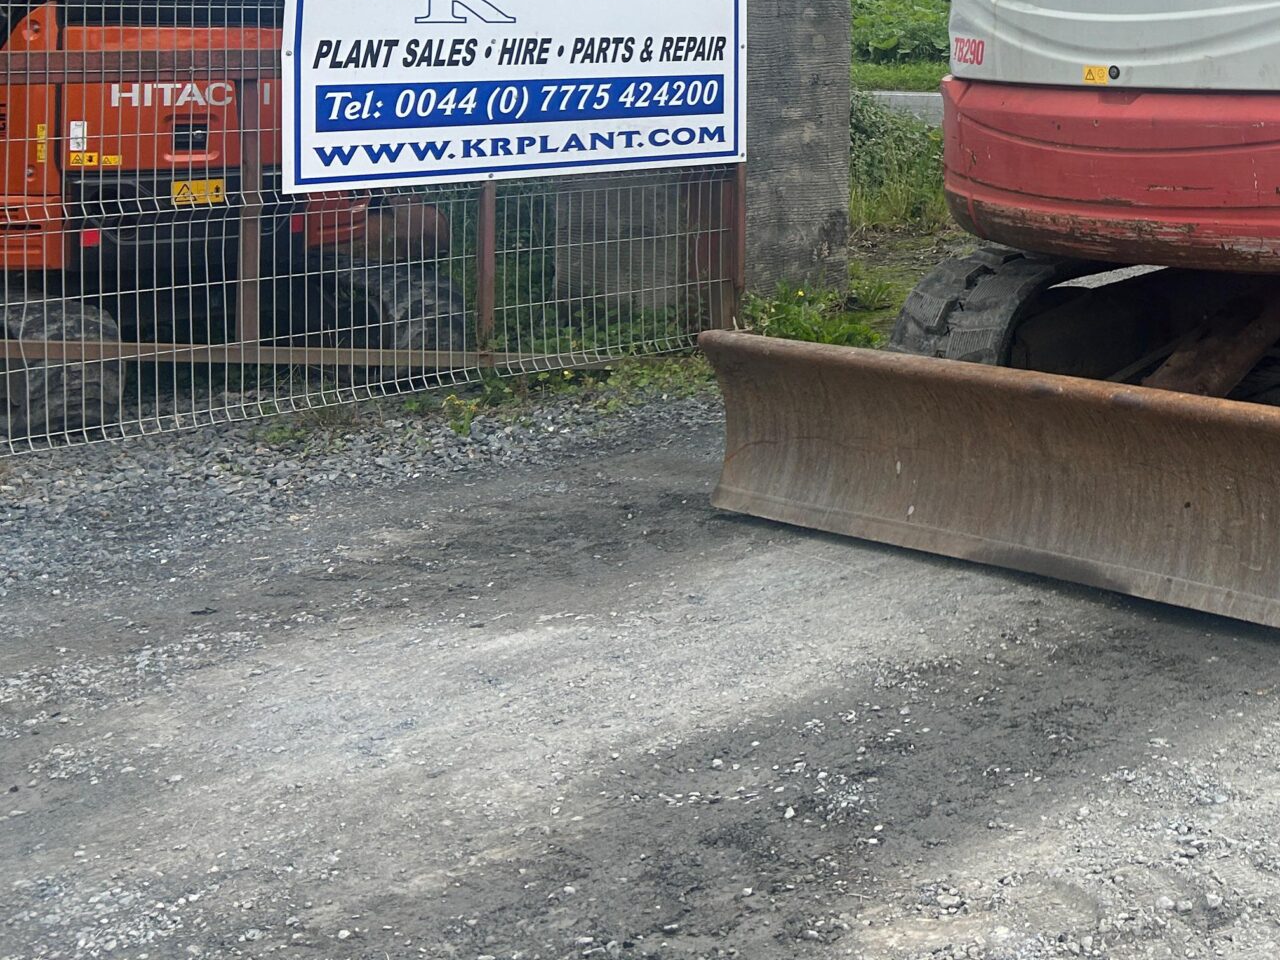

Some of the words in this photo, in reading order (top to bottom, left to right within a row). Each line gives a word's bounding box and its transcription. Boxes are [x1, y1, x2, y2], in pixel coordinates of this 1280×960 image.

[312, 39, 400, 69] PLANT
[402, 38, 478, 68] SALES
[498, 37, 552, 66] HIRE
[569, 37, 635, 64] PARTS
[640, 36, 654, 63] &
[659, 36, 727, 62] REPAIR
[954, 37, 985, 66] TB290
[110, 82, 271, 108] HITACI
[324, 90, 384, 120] Tel:
[395, 87, 478, 118] 0044
[486, 85, 529, 120] (0)
[540, 83, 612, 113] 7775
[618, 80, 719, 108] 424200
[312, 125, 726, 167] WWW.KRPLANT.COM
